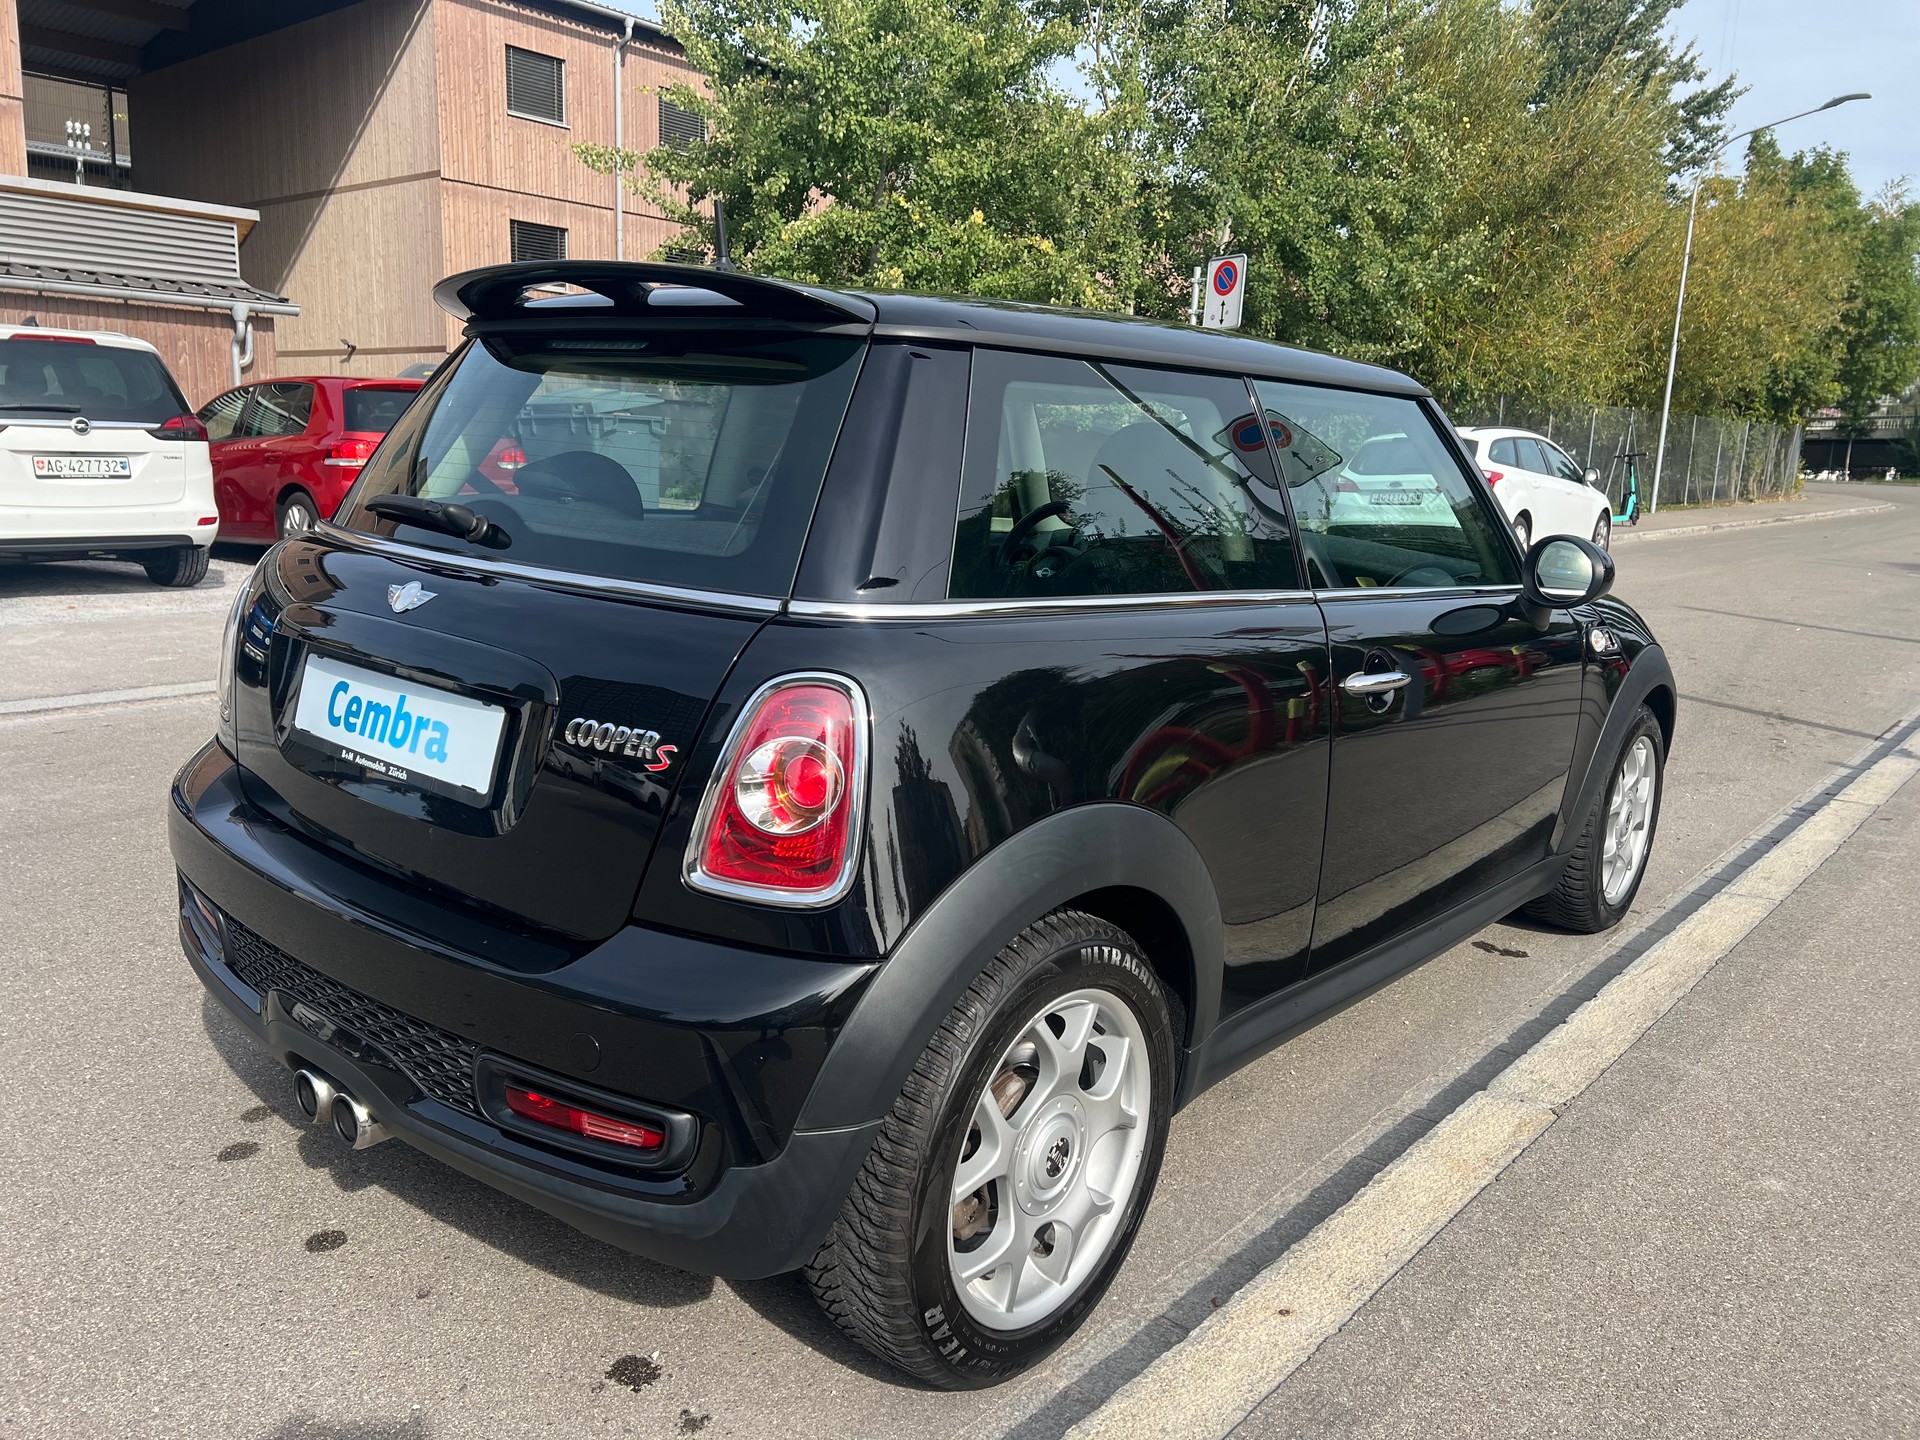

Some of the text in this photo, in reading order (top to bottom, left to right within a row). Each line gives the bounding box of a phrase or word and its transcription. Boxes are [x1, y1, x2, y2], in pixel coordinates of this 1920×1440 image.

[328, 680, 449, 763] Cembra
[565, 717, 678, 771] COOPER S
[354, 754, 386, 773] Automobile
[388, 766, 407, 781] Zürich
[1080, 946, 1161, 997] ULTRAGRIP
